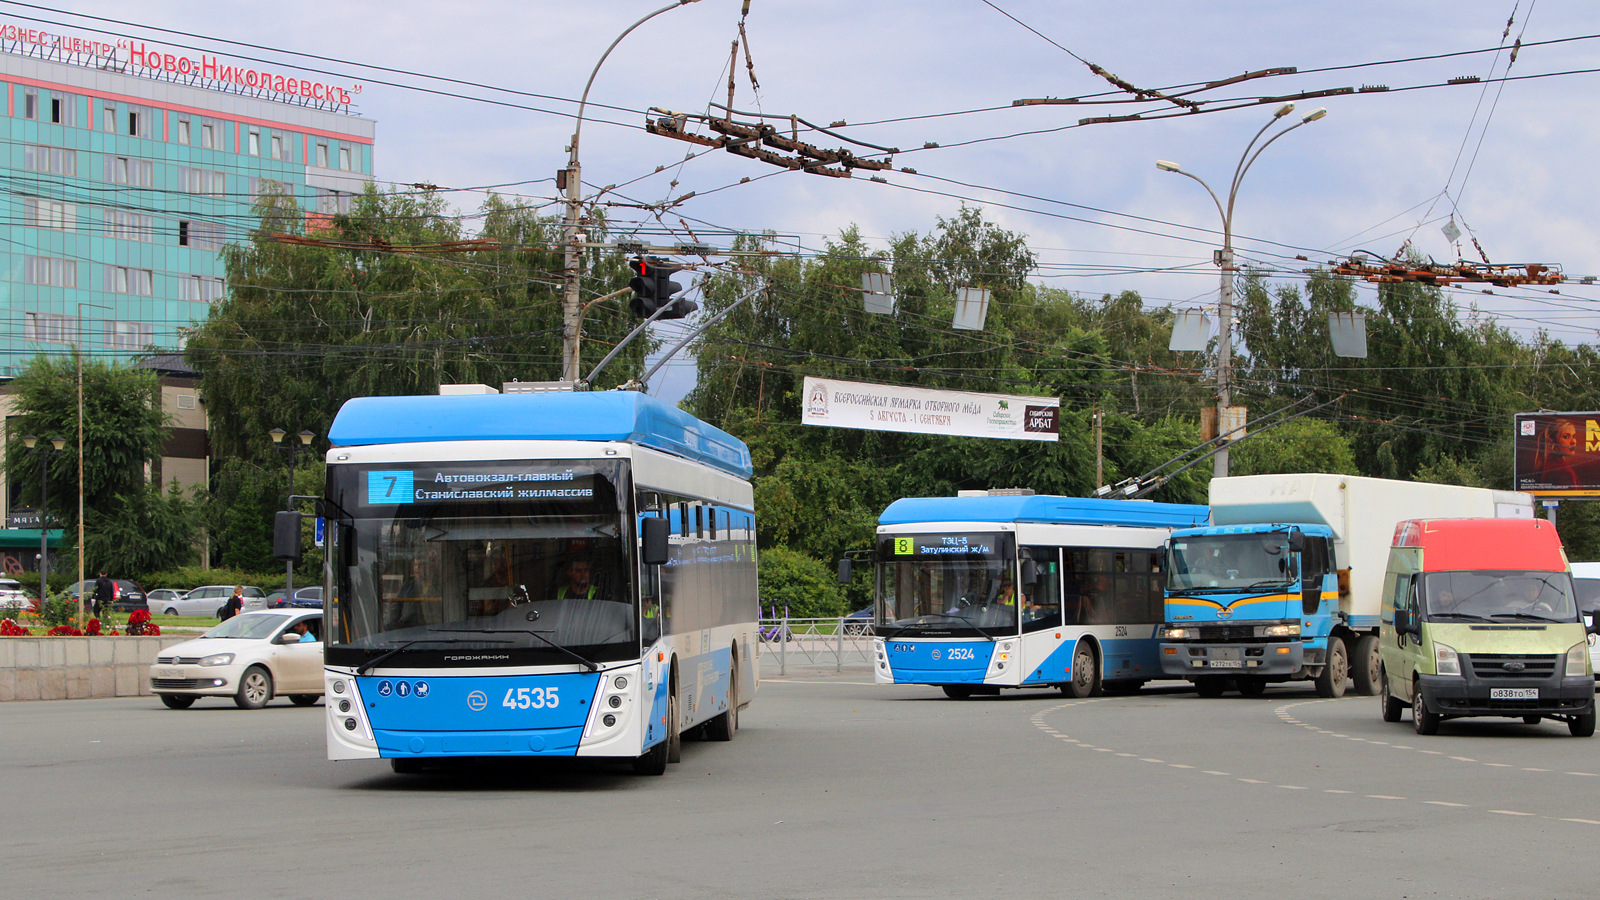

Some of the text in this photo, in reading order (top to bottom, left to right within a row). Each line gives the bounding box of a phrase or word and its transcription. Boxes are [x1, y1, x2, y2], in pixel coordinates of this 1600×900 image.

[890, 397, 921, 409] ЯРМАРКА
[924, 400, 960, 413] ОТБОРНОГО
[877, 410, 907, 423] АВГУСТА
[919, 414, 951, 426] СЕНТЯБРЯ
[1029, 418, 1053, 429] АРБАТ
[434, 468, 574, 484] Автовокзал-главный
[383, 476, 398, 498] 7
[415, 486, 594, 500] Станиславский жилмассив
[899, 539, 908, 553] 8
[941, 536, 968, 546] ТЭЦ-5
[920, 545, 969, 555] Затулинский
[1115, 626, 1128, 637] 2524
[947, 648, 975, 660] 2524
[502, 687, 560, 710] 4535
